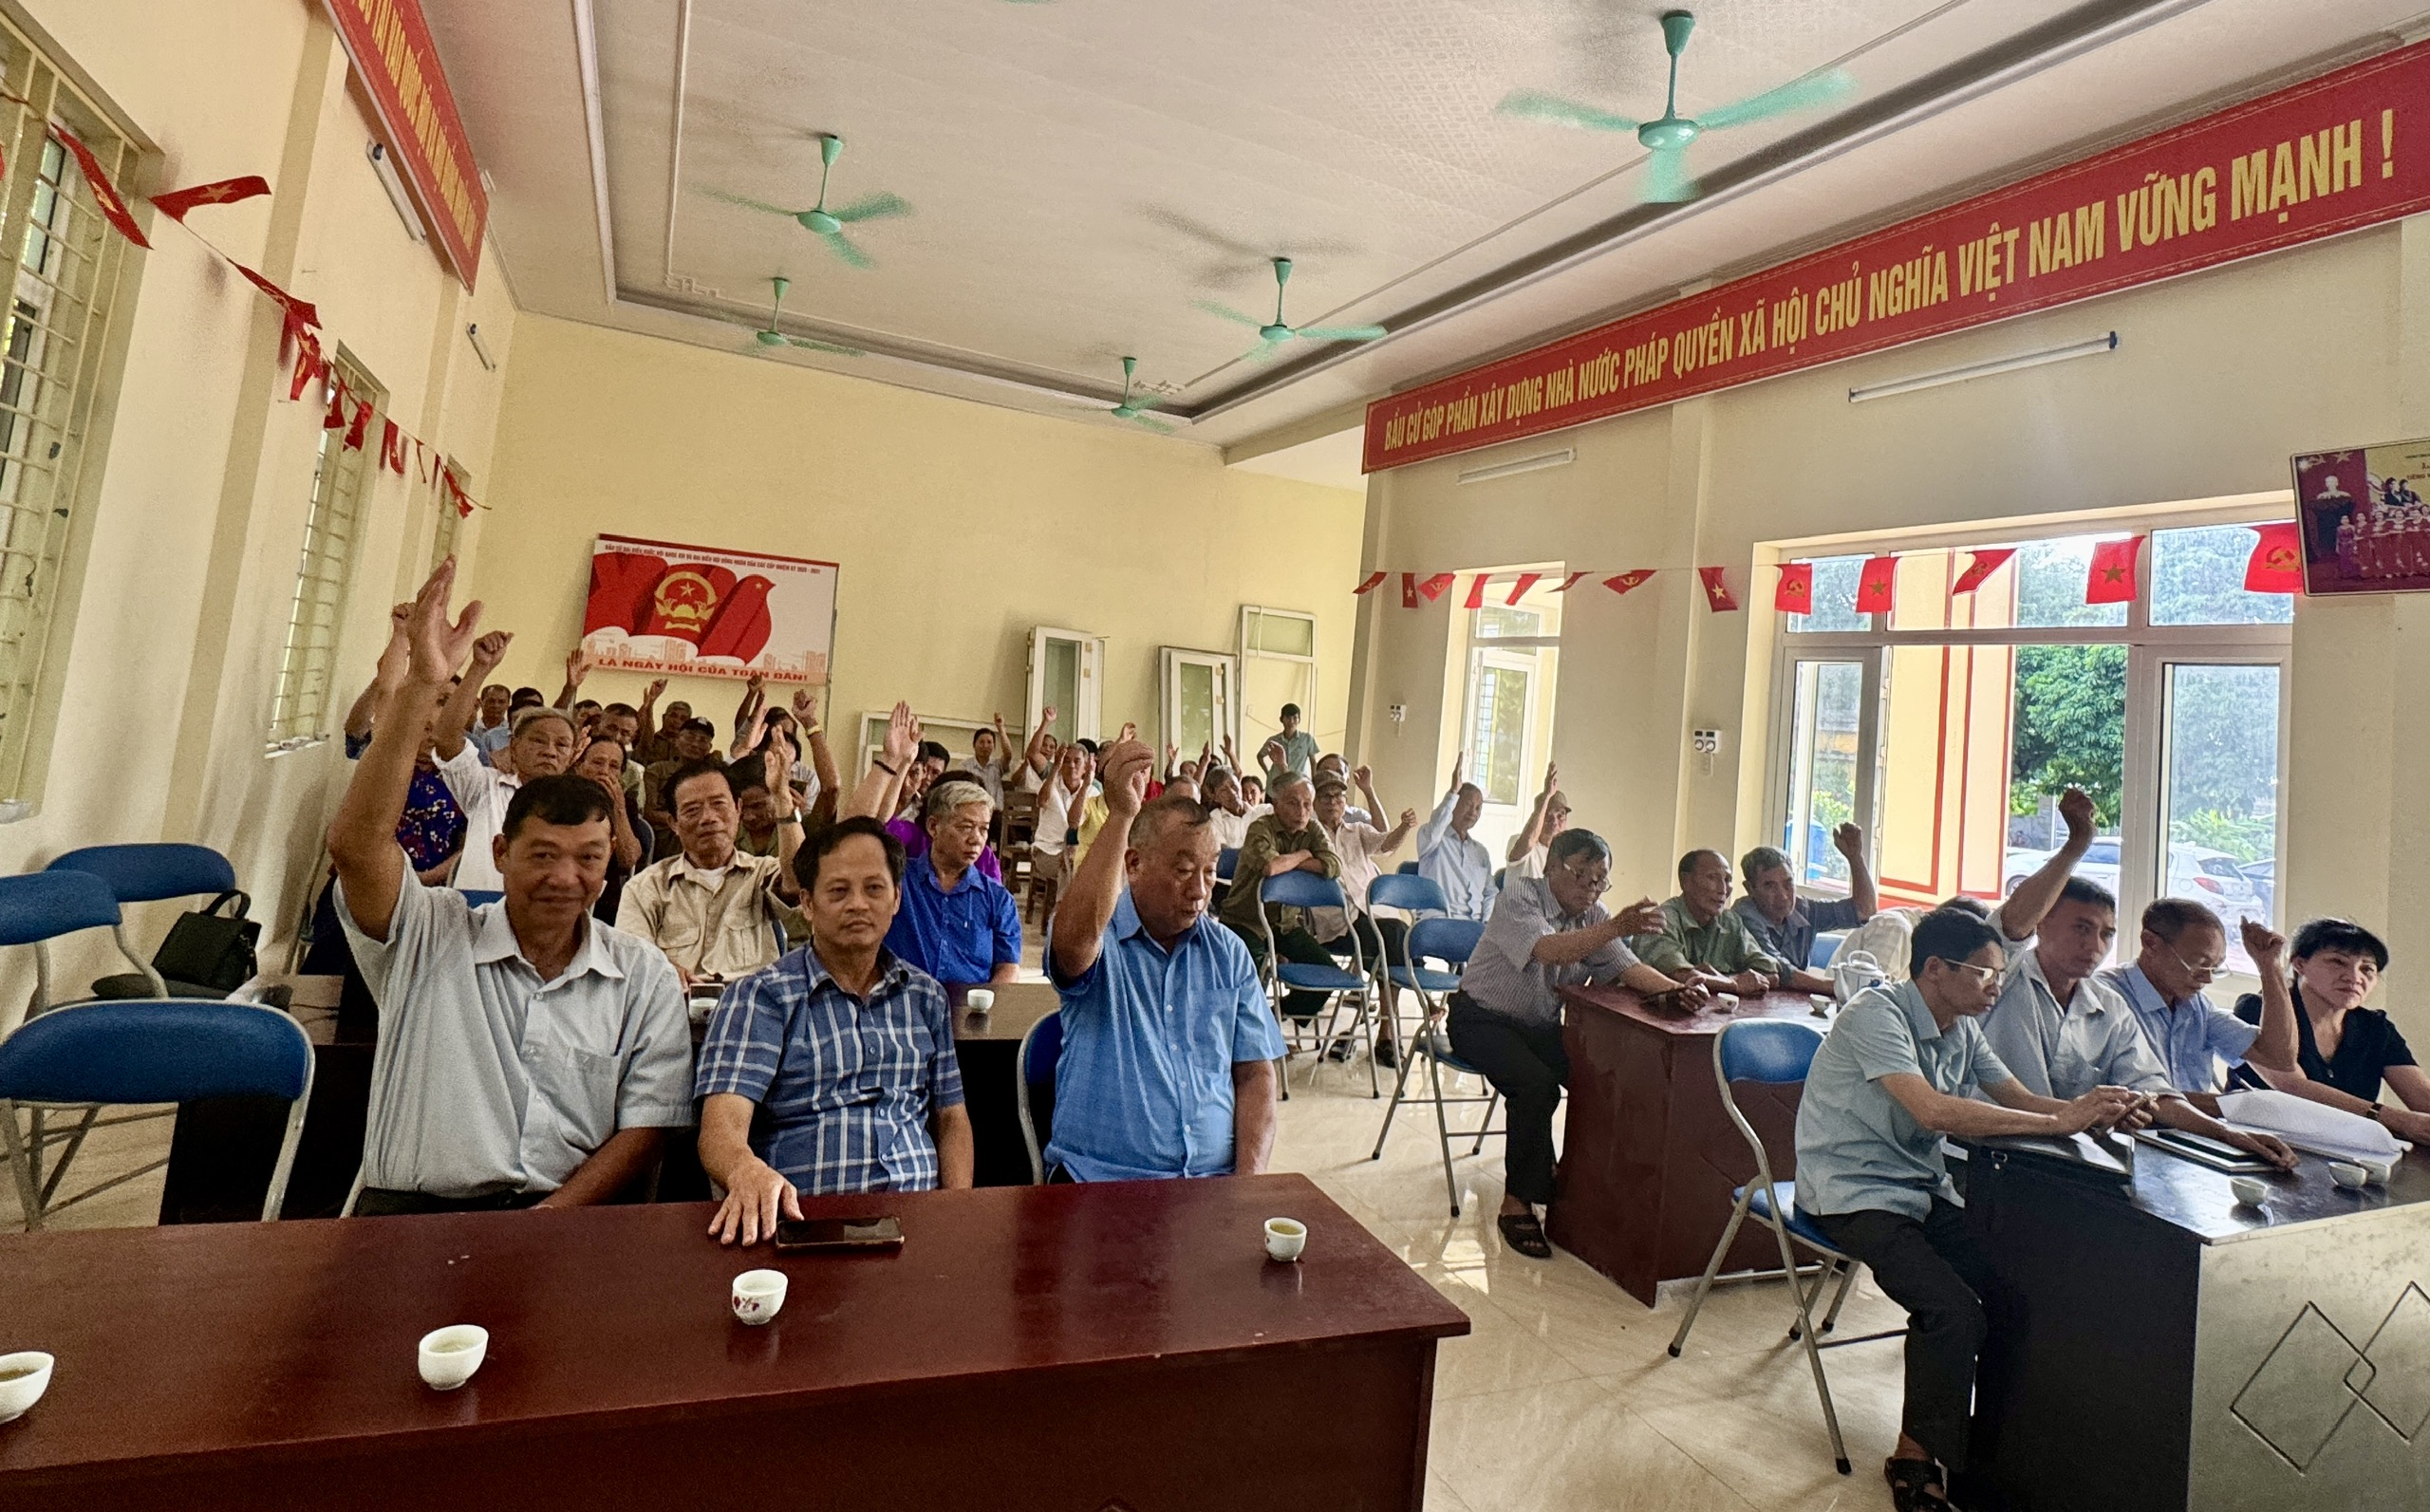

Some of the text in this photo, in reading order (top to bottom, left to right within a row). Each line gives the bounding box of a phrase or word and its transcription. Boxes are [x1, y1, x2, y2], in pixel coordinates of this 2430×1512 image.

[1384, 108, 2394, 451] BẦU CỬ GÓP PHẦN XÂY DỰNG NHÀ NƯỚC PHÁP QUYỀN XÃ HỘI CHỦ NGHĨA VIỆT NAM VỮNG MẠNH !
[622, 659, 664, 670] NGÀY
[667, 663, 693, 673] HỘI
[698, 665, 727, 676] CỦA
